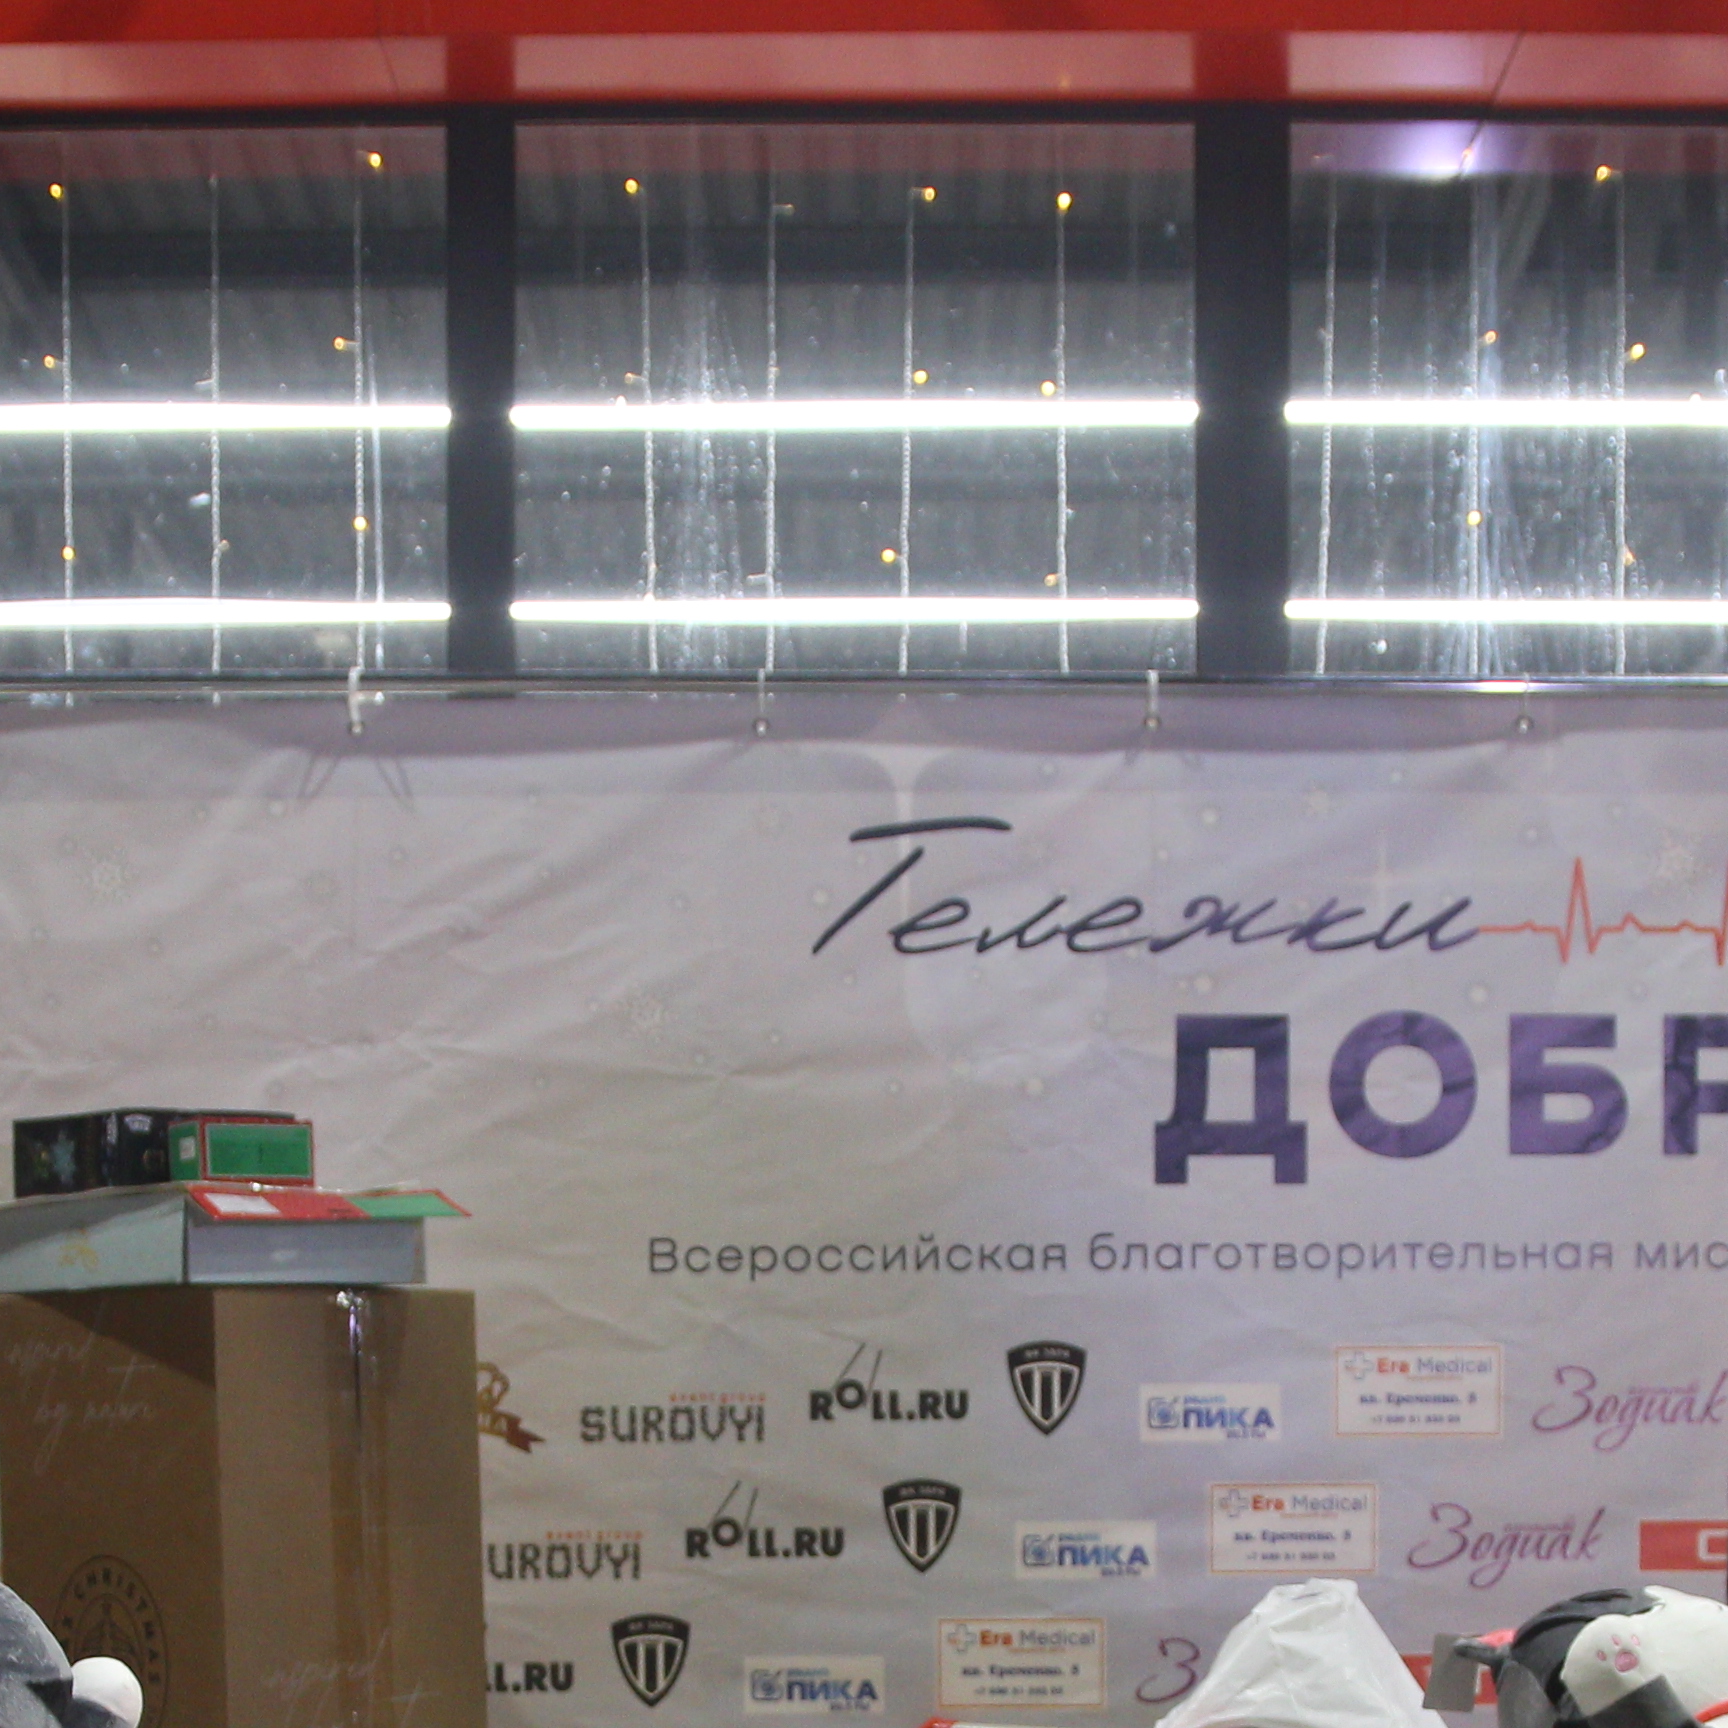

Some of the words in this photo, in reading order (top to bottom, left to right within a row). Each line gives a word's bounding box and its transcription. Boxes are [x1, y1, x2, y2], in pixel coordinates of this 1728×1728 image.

[812, 817, 1480, 955] Тележки
[646, 1233, 1068, 1276] Всероссийская
[1088, 1231, 1614, 1277] благотворительная
[1417, 1357, 1493, 1373] Medical
[809, 1379, 970, 1421] ROLL.RU
[580, 1405, 765, 1442] SUROVYI
[1183, 1408, 1275, 1429] ПИКА
[1292, 1494, 1368, 1511] Medical
[686, 1517, 844, 1558] ROLL.RU
[487, 1543, 641, 1580] UROVYI
[1057, 1546, 1149, 1567] ПИКА
[1020, 1630, 1096, 1646] Medical
[487, 1663, 574, 1692] L.RU
[787, 1680, 878, 1701] ПИКА
